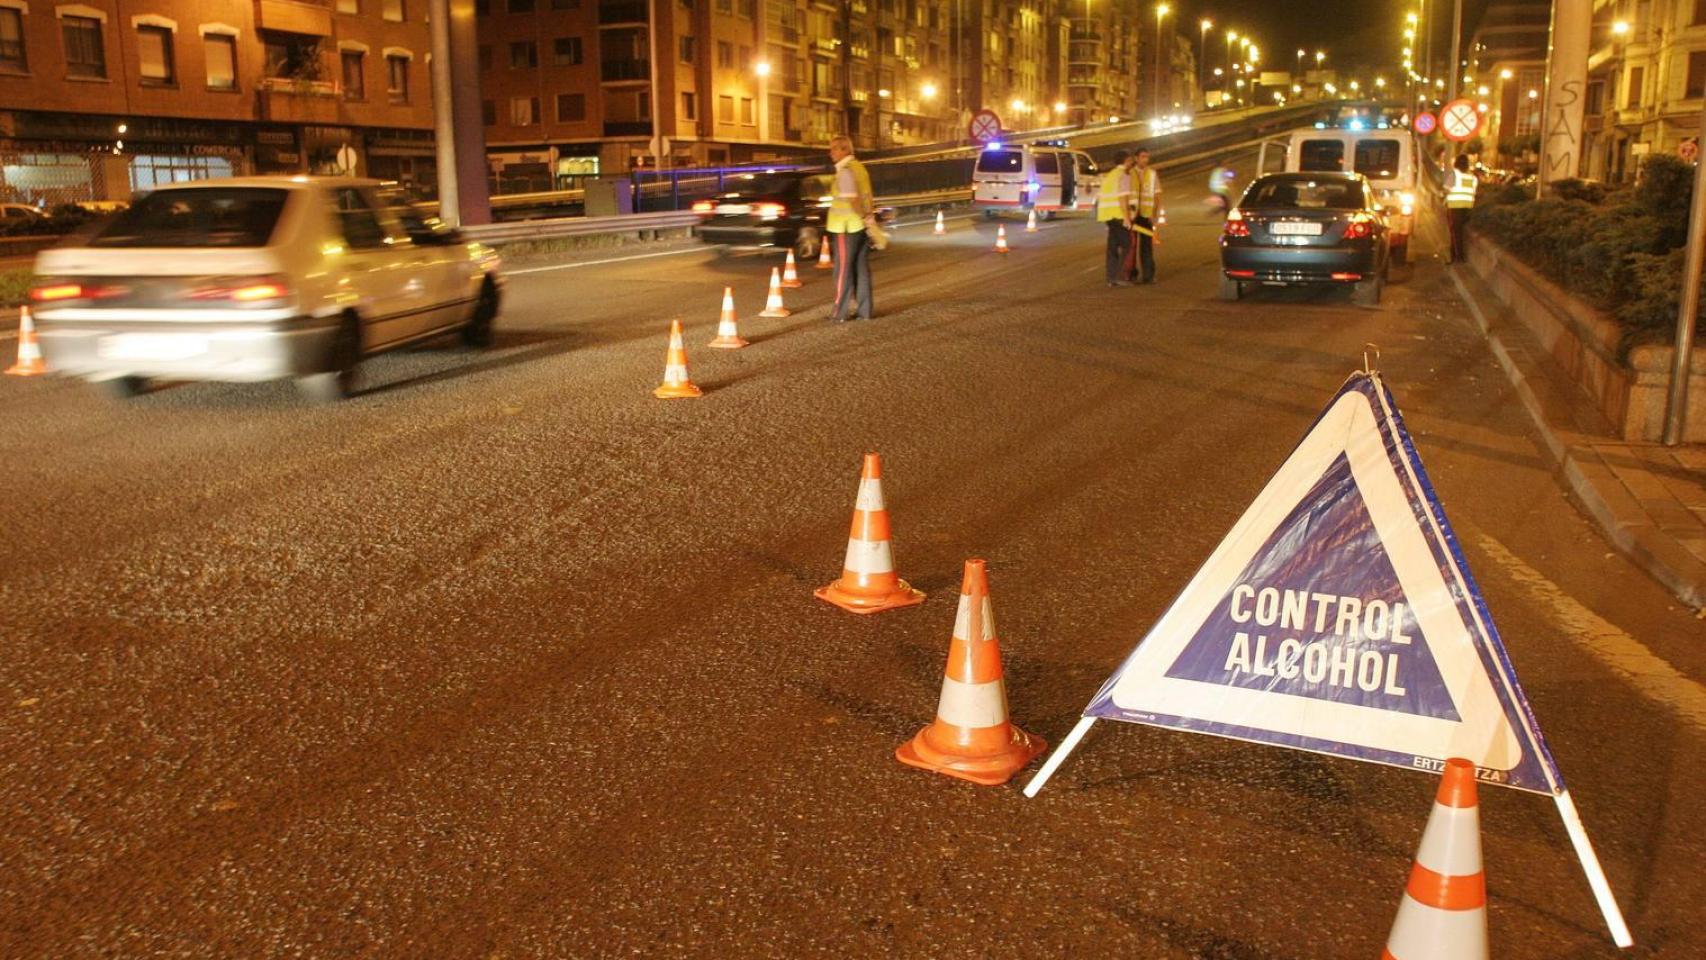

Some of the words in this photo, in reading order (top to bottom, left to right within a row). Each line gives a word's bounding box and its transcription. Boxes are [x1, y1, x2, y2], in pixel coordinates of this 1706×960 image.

[1230, 584, 1412, 645] CONTROL
[1224, 632, 1406, 697] ALCOHOL
[1413, 756, 1500, 782] ERTZTZA
